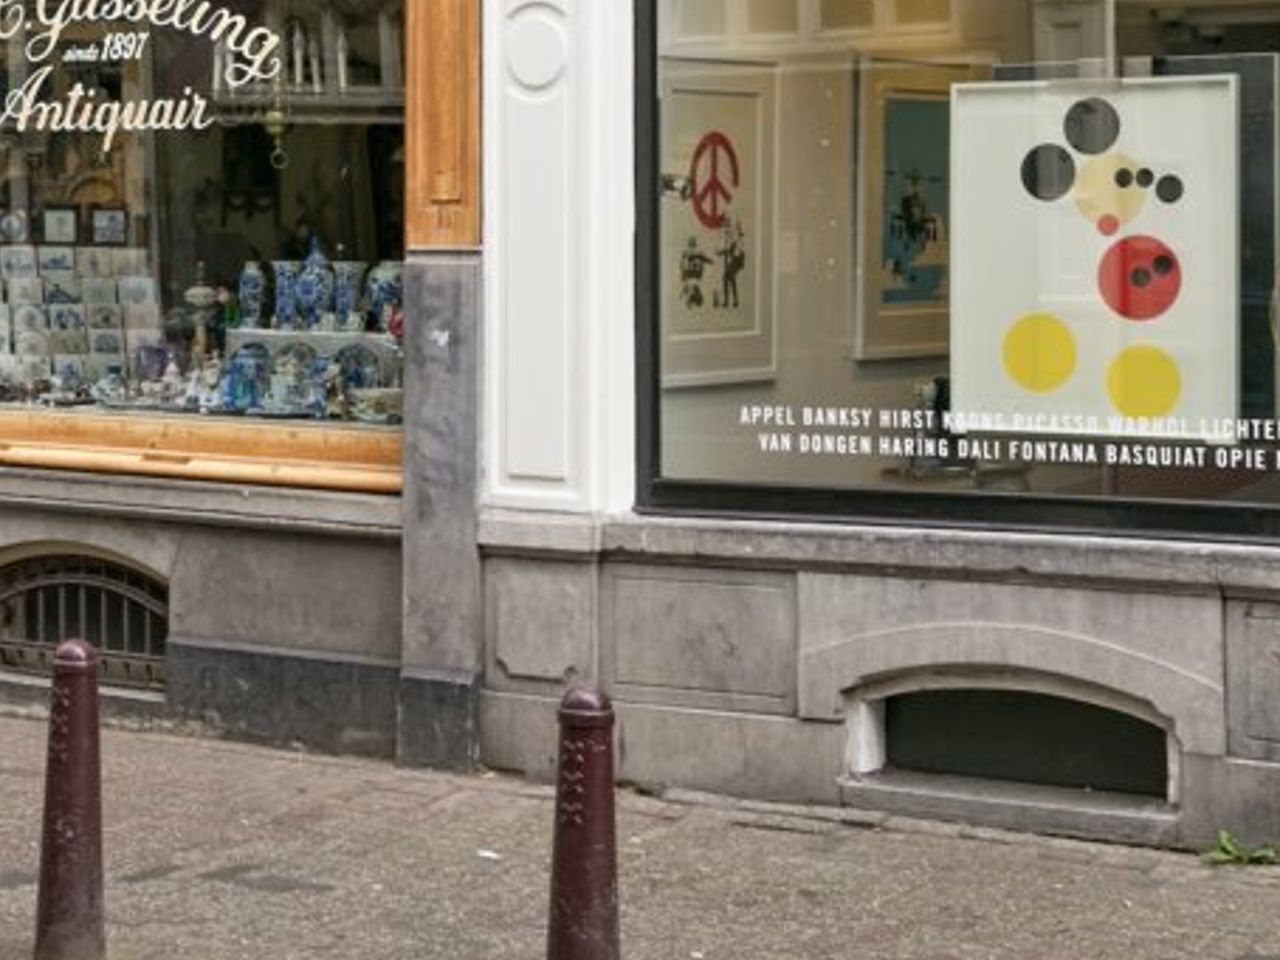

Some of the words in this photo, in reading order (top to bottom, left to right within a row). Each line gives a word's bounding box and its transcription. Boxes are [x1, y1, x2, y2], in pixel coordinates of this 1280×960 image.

[100, 32, 150, 61] 1897
[740, 405, 796, 426] APPEL
[802, 406, 872, 428] BANKSY
[879, 409, 934, 429] HIRST
[758, 433, 792, 452] VAN
[800, 434, 872, 454] DONGEN
[879, 438, 949, 457] HARING
[958, 440, 1000, 459] DALI
[1009, 441, 1097, 462] FONTANA
[1105, 444, 1206, 467] BASQUIAT
[1215, 447, 1266, 470] OPIE
